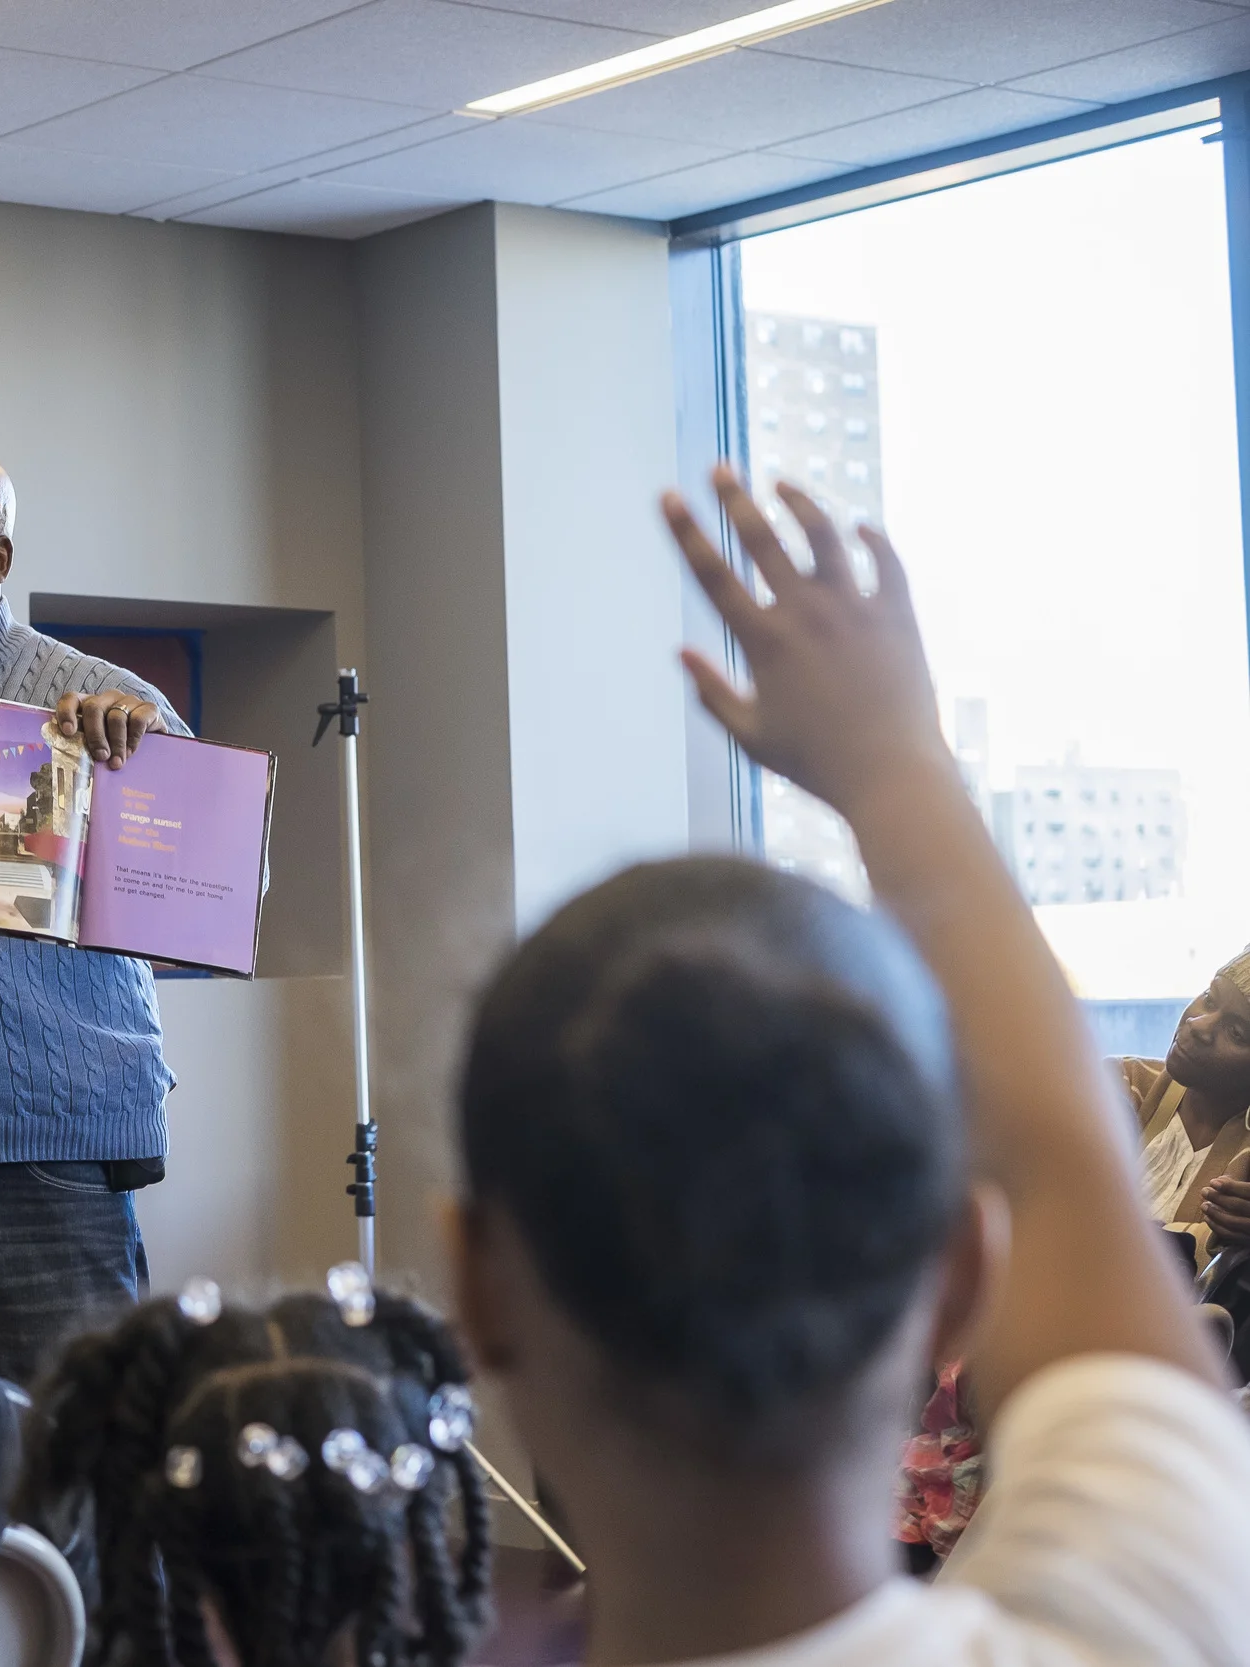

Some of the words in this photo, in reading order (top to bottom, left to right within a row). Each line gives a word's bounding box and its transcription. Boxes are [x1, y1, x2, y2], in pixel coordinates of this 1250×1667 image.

[120, 812, 150, 824] orange
[153, 818, 182, 829] sunset
[116, 865, 129, 873] That
[131, 869, 151, 877] means
[164, 874, 177, 882] time
[190, 878, 199, 886] the
[123, 877, 140, 885] come
[152, 882, 164, 890] and
